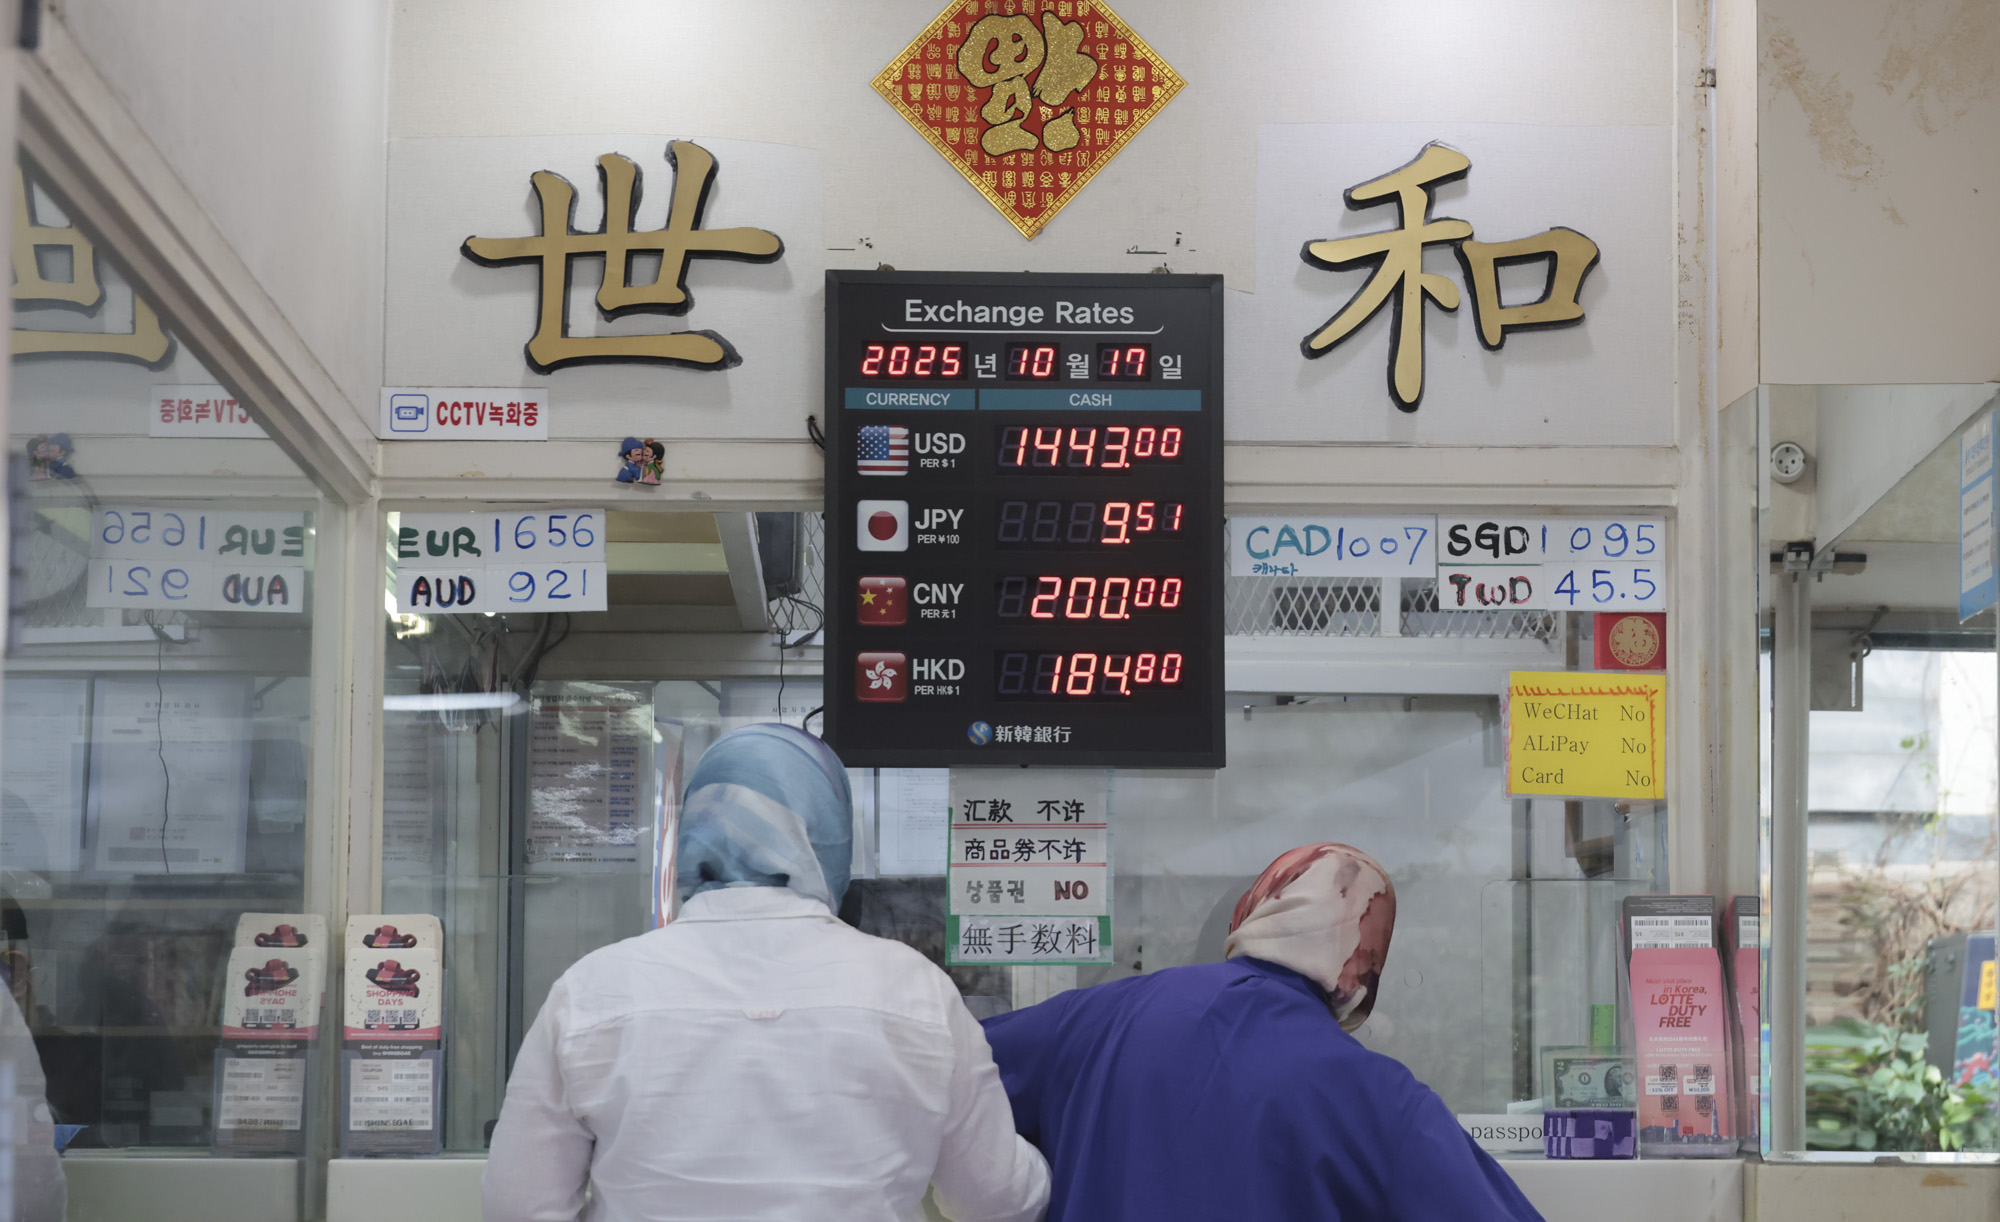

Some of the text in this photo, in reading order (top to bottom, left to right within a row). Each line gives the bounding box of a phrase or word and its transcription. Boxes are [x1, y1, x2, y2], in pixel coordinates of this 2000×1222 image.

[460, 139, 1601, 413] 世 和
[905, 299, 1134, 326] Exchange Rates
[862, 346, 1182, 380] 2025 년 10 월 17 일
[866, 392, 1112, 407] CURRENCY CASH
[436, 401, 538, 427] CCTV녹화중
[915, 427, 1182, 468] USD 1443.00
[920, 458, 939, 468] PER
[914, 502, 1182, 544] JPY 9.51
[398, 514, 595, 558] EUR 1656
[917, 534, 960, 544] PER ¥100
[1246, 524, 1428, 566] CAD 1007
[1447, 521, 1656, 559] SGD 1095
[411, 568, 587, 608] AUD 921
[913, 577, 1182, 619] CNY 200.00
[1554, 569, 1656, 606] 45.5
[920, 609, 940, 618] PER
[913, 653, 1182, 696] HKD 184.80
[914, 685, 934, 695] PER
[1524, 702, 1645, 722] WeCHat No
[995, 725, 1072, 743] 新韓銀行
[1523, 735, 1646, 755] ALiPay No
[1522, 766, 1651, 787] Card No
[963, 799, 1085, 823] 汇款 不许
[966, 880, 1088, 904] 상품권 NO
[962, 923, 1097, 955] 無手数料
[1650, 993, 1694, 1005] LOTTE
[1663, 985, 1707, 994] in Korea,
[1659, 1016, 1692, 1028] FREE
[1668, 1005, 1707, 1016] DUTY
[366, 1119, 414, 1127] SHINSEGAE
[1471, 1126, 1544, 1142] passpo
